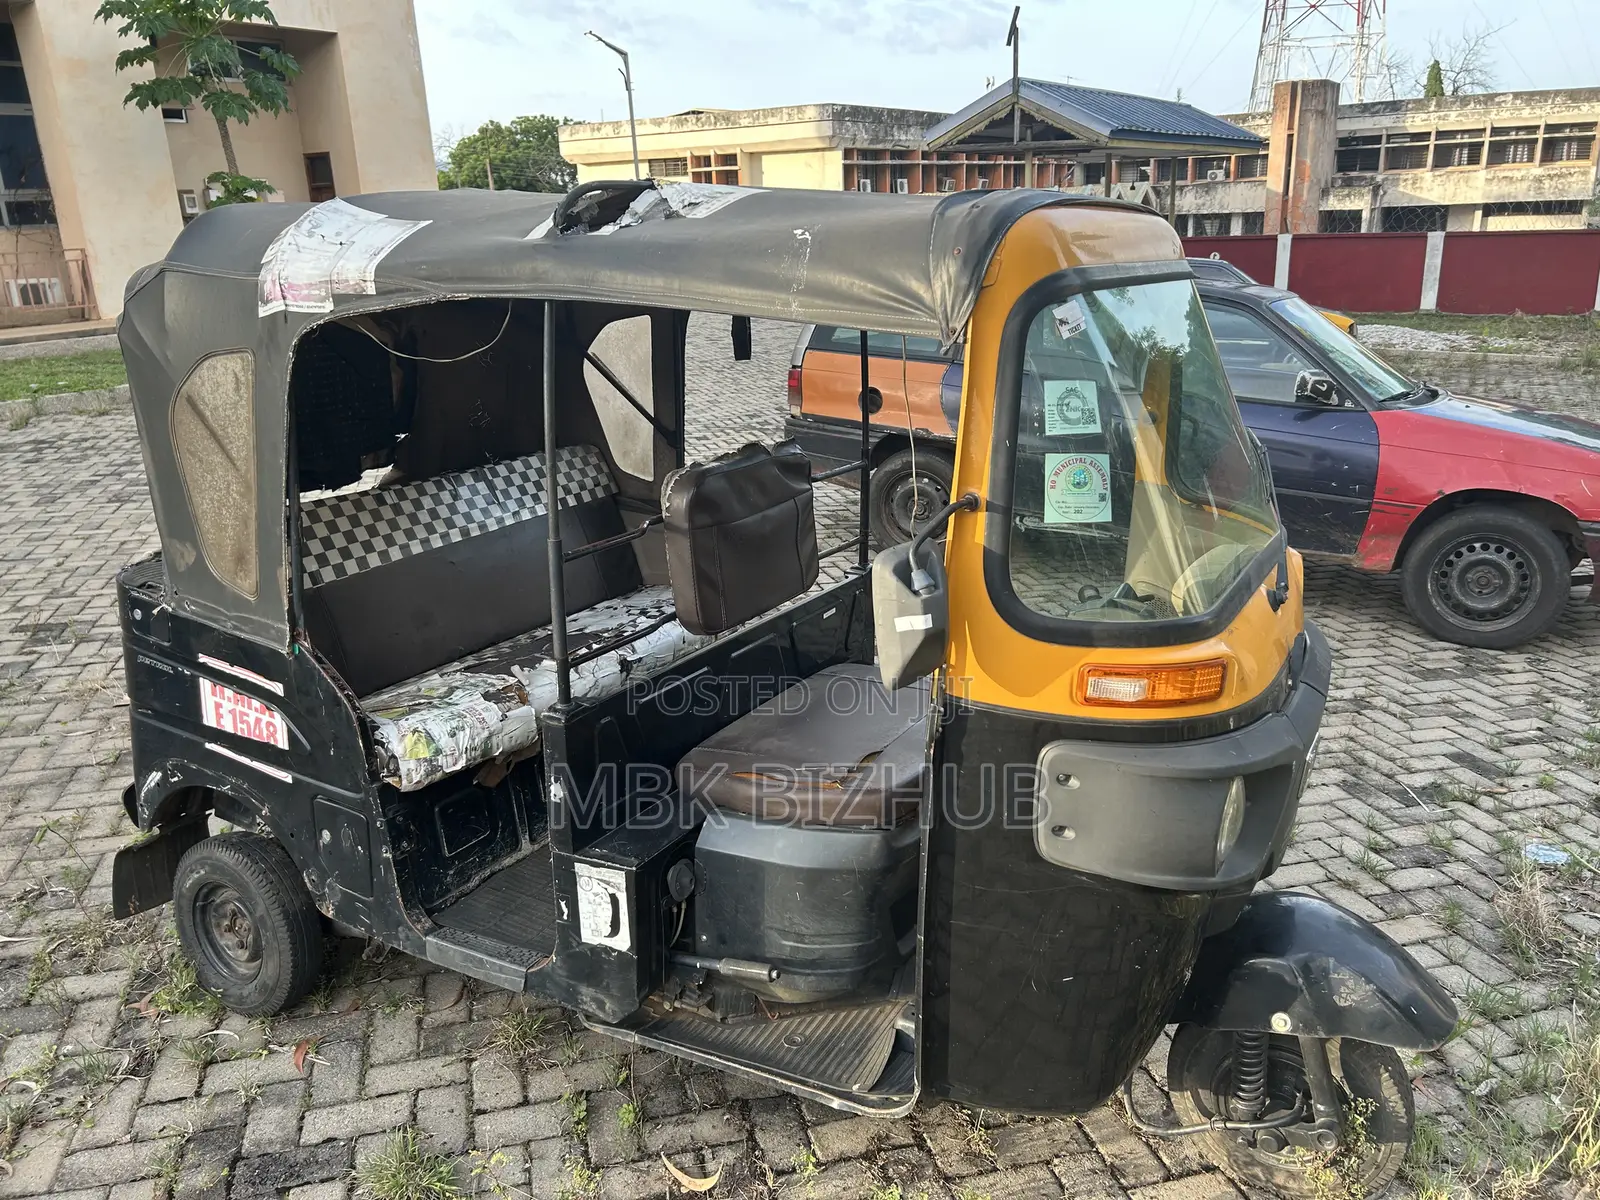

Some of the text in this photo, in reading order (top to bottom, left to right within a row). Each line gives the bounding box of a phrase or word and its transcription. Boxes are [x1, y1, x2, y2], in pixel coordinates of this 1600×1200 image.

[1049, 479, 1057, 490] HO
[1053, 457, 1088, 478] MUNICIPAL
[1088, 460, 1109, 491] ASSEMBLY
[214, 701, 279, 745] E 1548
